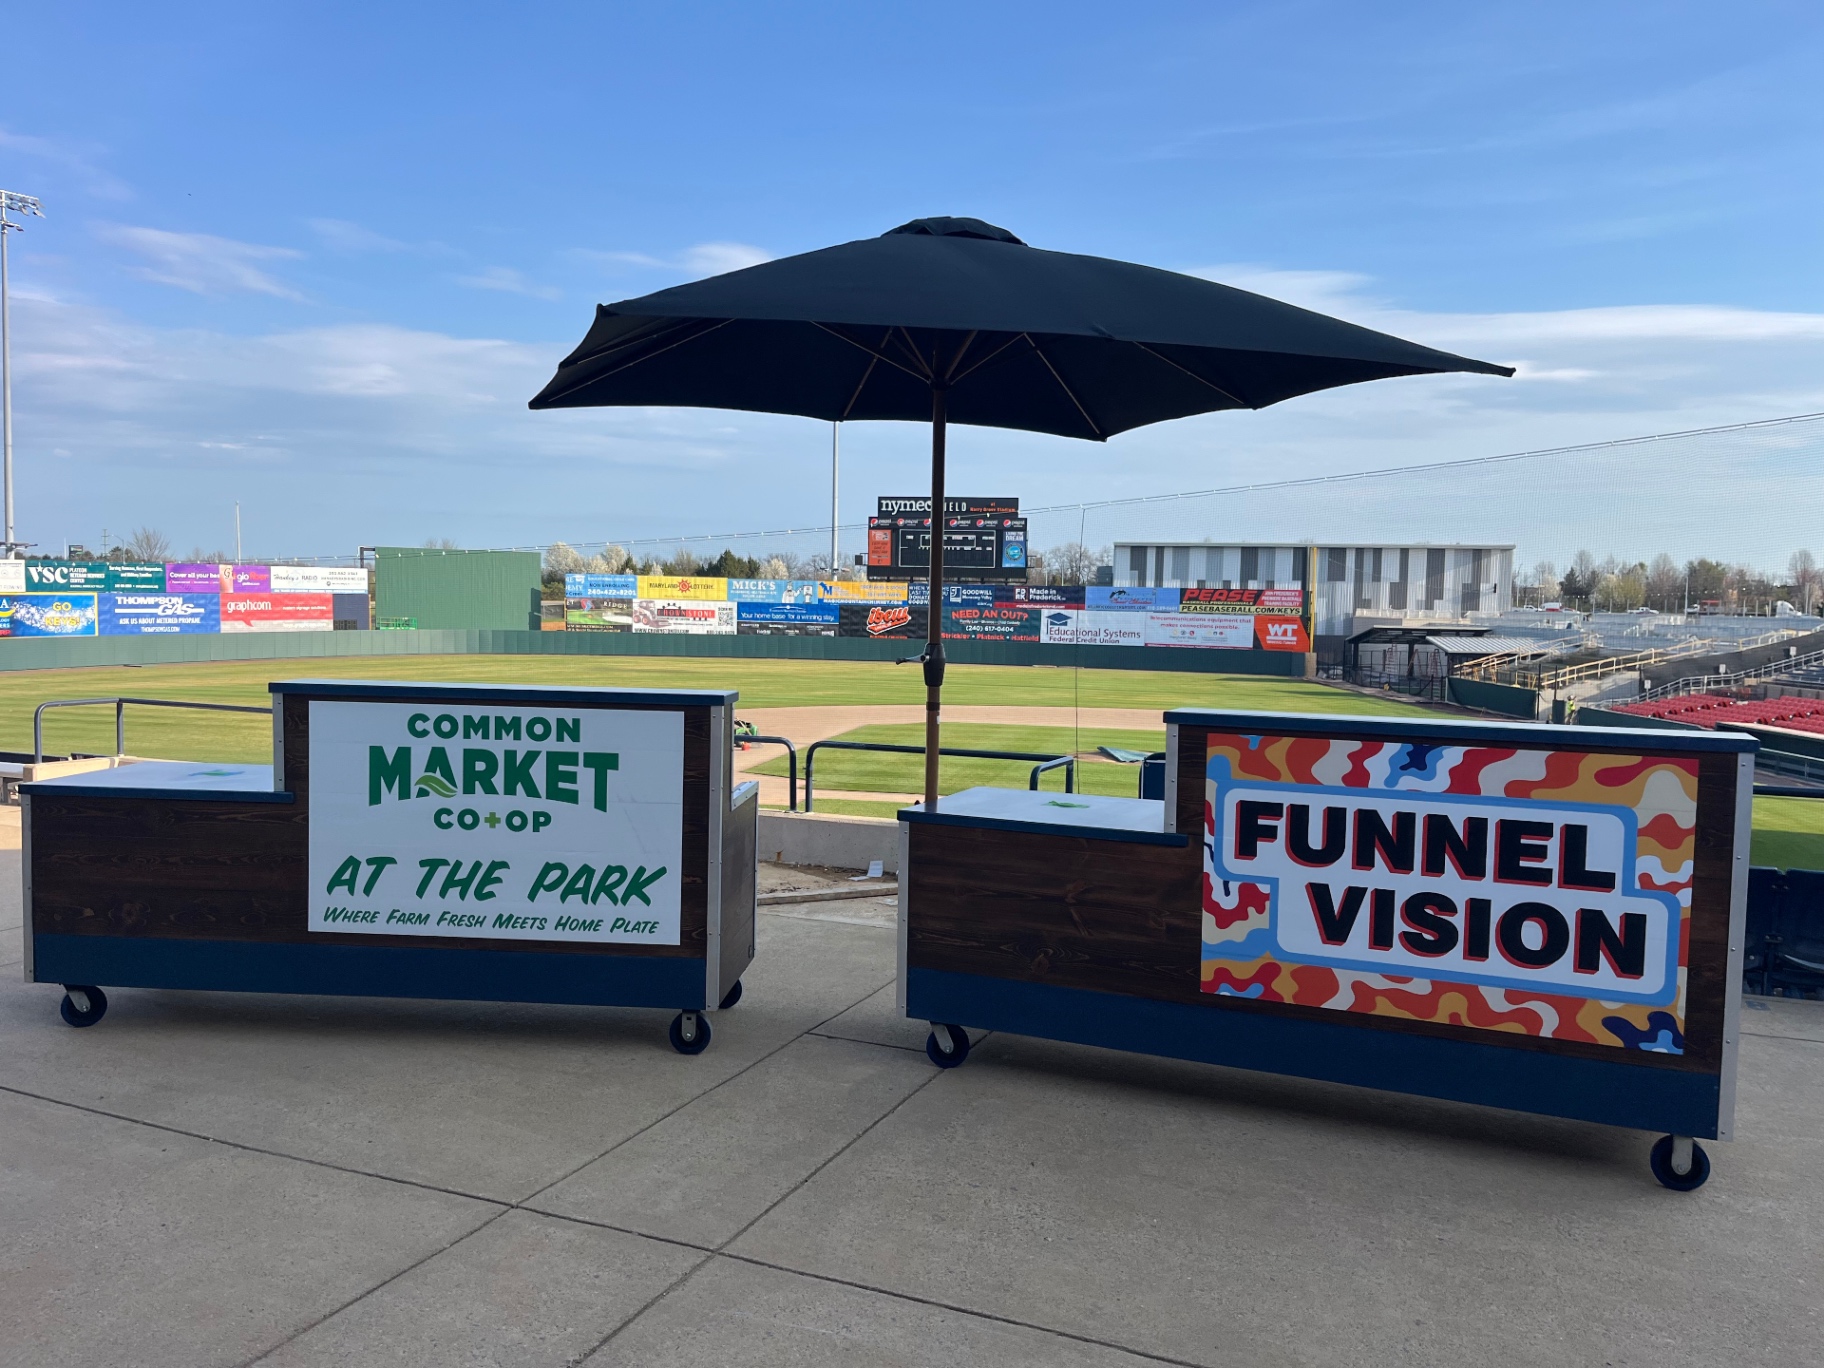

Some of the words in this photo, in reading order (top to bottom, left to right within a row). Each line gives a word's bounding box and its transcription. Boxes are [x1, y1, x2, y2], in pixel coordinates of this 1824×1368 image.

[943, 502, 967, 512] IELD
[27, 565, 69, 584] VSC
[732, 581, 776, 590] MICK'S
[115, 596, 183, 605] THOMPSON
[1183, 589, 1258, 602] PEASE
[52, 601, 72, 611] GO
[157, 604, 195, 616] GAS
[227, 599, 272, 613] graphcom
[603, 601, 628, 609] RIDGE
[1181, 605, 1301, 615] PEASEBASEBALL.COM/KEYS
[951, 609, 980, 619] NEED
[982, 610, 998, 618] AN
[1000, 611, 1029, 620] OUT?
[45, 616, 80, 626] KEYS!
[1049, 627, 1101, 637] Educational
[1103, 629, 1141, 639] Systems
[1267, 623, 1298, 637] WT
[407, 713, 581, 744] COMMON
[369, 745, 620, 813] MARKET
[1233, 799, 1617, 893] FUNNEL
[326, 855, 397, 898] AT
[415, 858, 511, 902] THE
[527, 861, 668, 907] PARK
[323, 906, 380, 924] WHERE
[386, 908, 431, 927] FARM
[436, 910, 487, 929] FRESH
[492, 913, 548, 931] MEETS
[554, 915, 604, 933] HOME
[610, 916, 660, 935] PLATE
[1304, 882, 1648, 980] VISION
